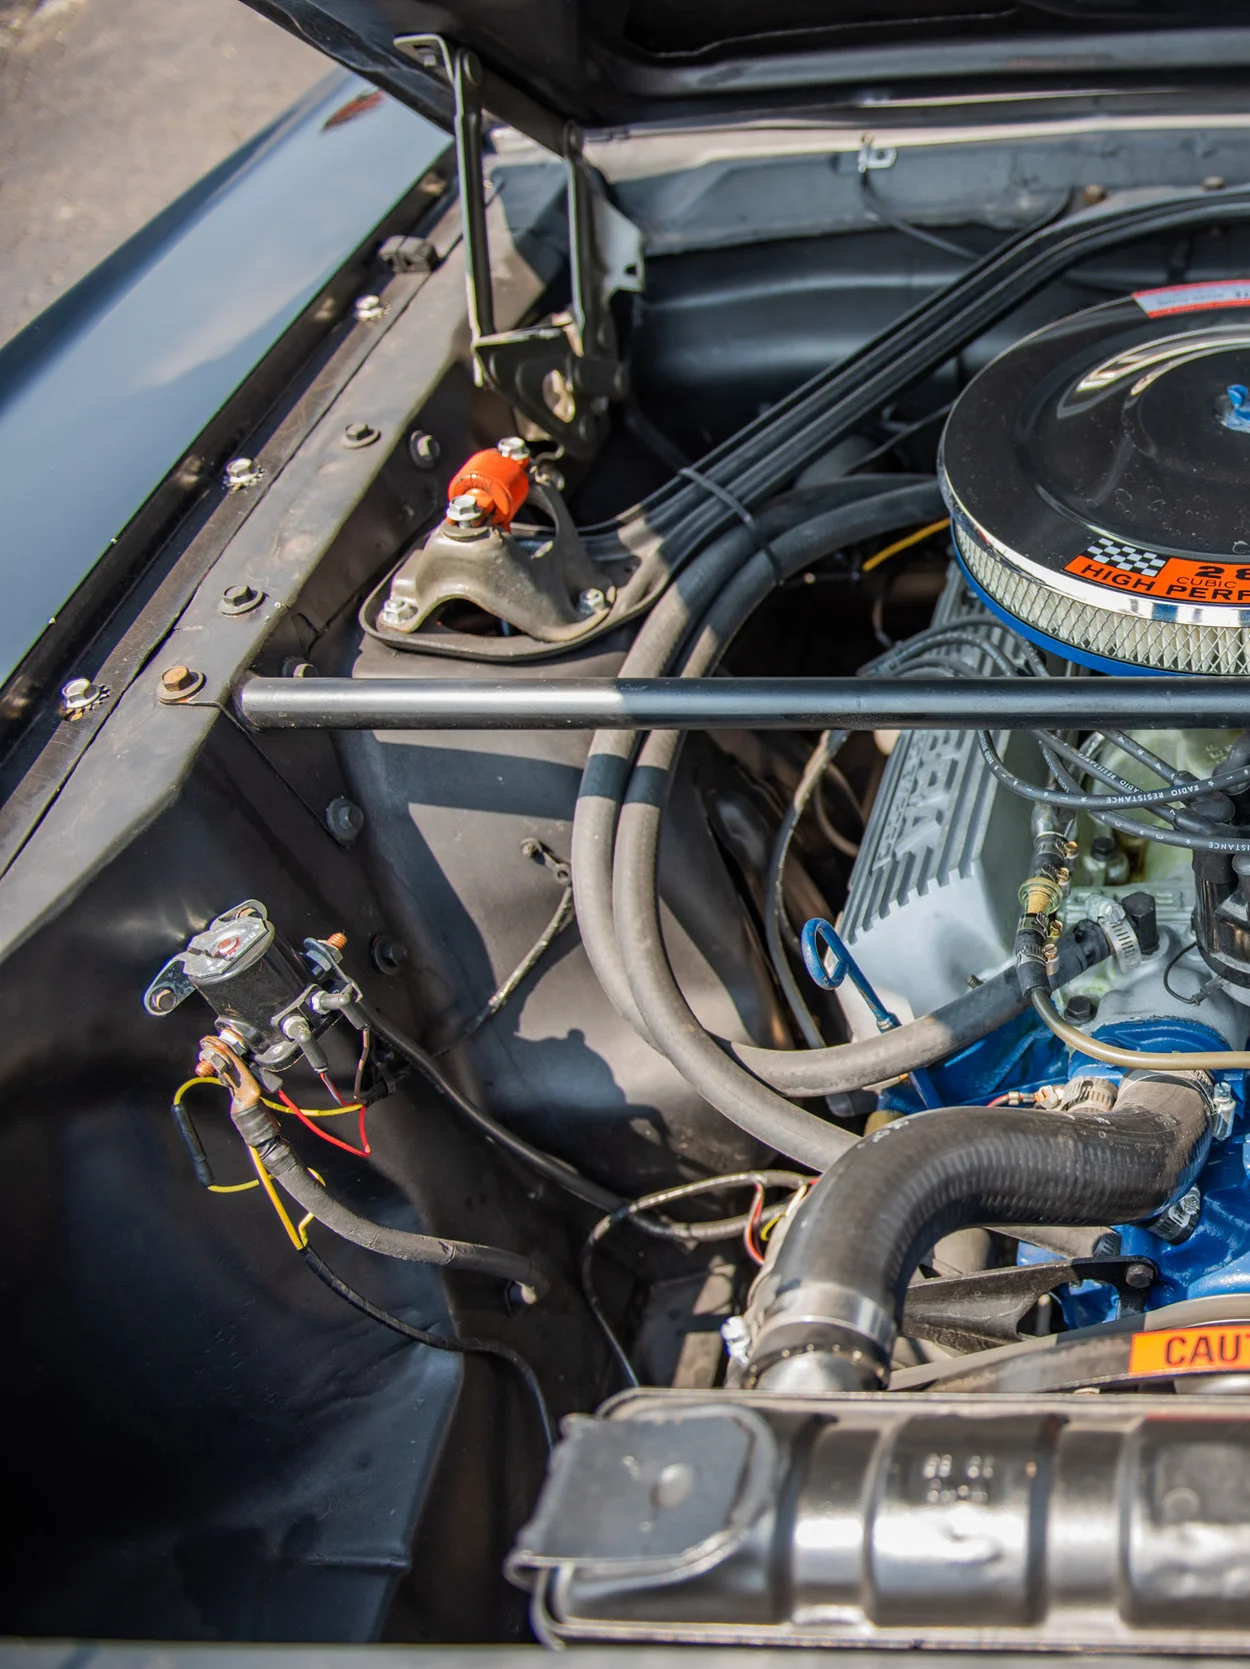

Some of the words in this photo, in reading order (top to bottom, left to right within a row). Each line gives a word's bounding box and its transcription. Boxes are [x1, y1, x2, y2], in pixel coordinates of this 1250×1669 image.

[1081, 563, 1154, 592] HIGH
[1176, 576, 1236, 589] CUBIC
[1105, 791, 1164, 804] RESISTANCE
[1170, 784, 1200, 797] RADIO
[1118, 780, 1144, 793] ADIO
